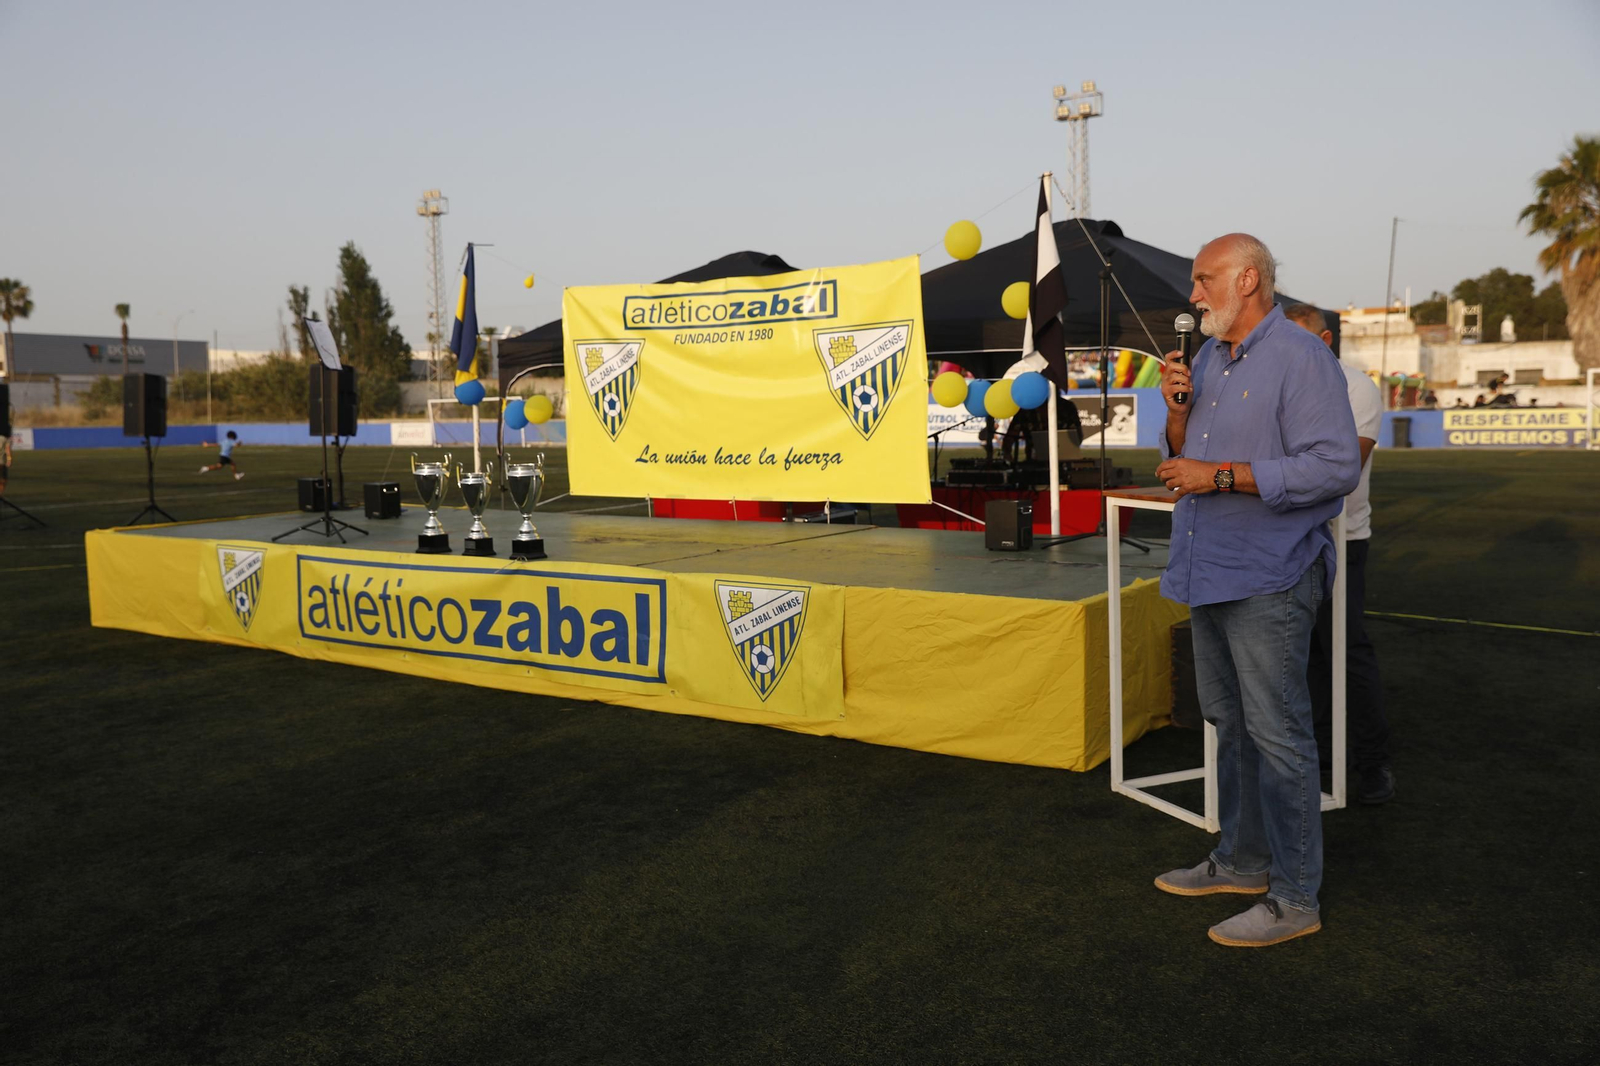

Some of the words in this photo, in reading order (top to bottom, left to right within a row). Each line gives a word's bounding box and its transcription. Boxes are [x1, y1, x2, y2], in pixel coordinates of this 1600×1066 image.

[630, 287, 828, 325] atléticozabal
[674, 331, 728, 345] FUNDADO
[730, 330, 745, 342] EN
[748, 328, 774, 341] 1980
[590, 376, 601, 388] ATL.
[599, 364, 617, 381] ZABAL
[616, 347, 635, 368] LINENSE
[836, 369, 850, 382] ATL.
[850, 353, 874, 372] ZABAL
[873, 331, 904, 357] LINENSE
[1448, 430, 1568, 446] QUEREMOS
[1450, 411, 1569, 427] RESPÉTAME
[1578, 412, 1588, 426] Y
[635, 444, 659, 464] La
[664, 450, 708, 465] unión
[714, 446, 752, 466] hace
[758, 447, 777, 465] la
[783, 446, 844, 471] fuerza
[307, 573, 651, 667] atléticozabal
[734, 624, 751, 636] ATL.
[750, 611, 773, 628] ZABAL
[771, 596, 802, 617] LINENSE
